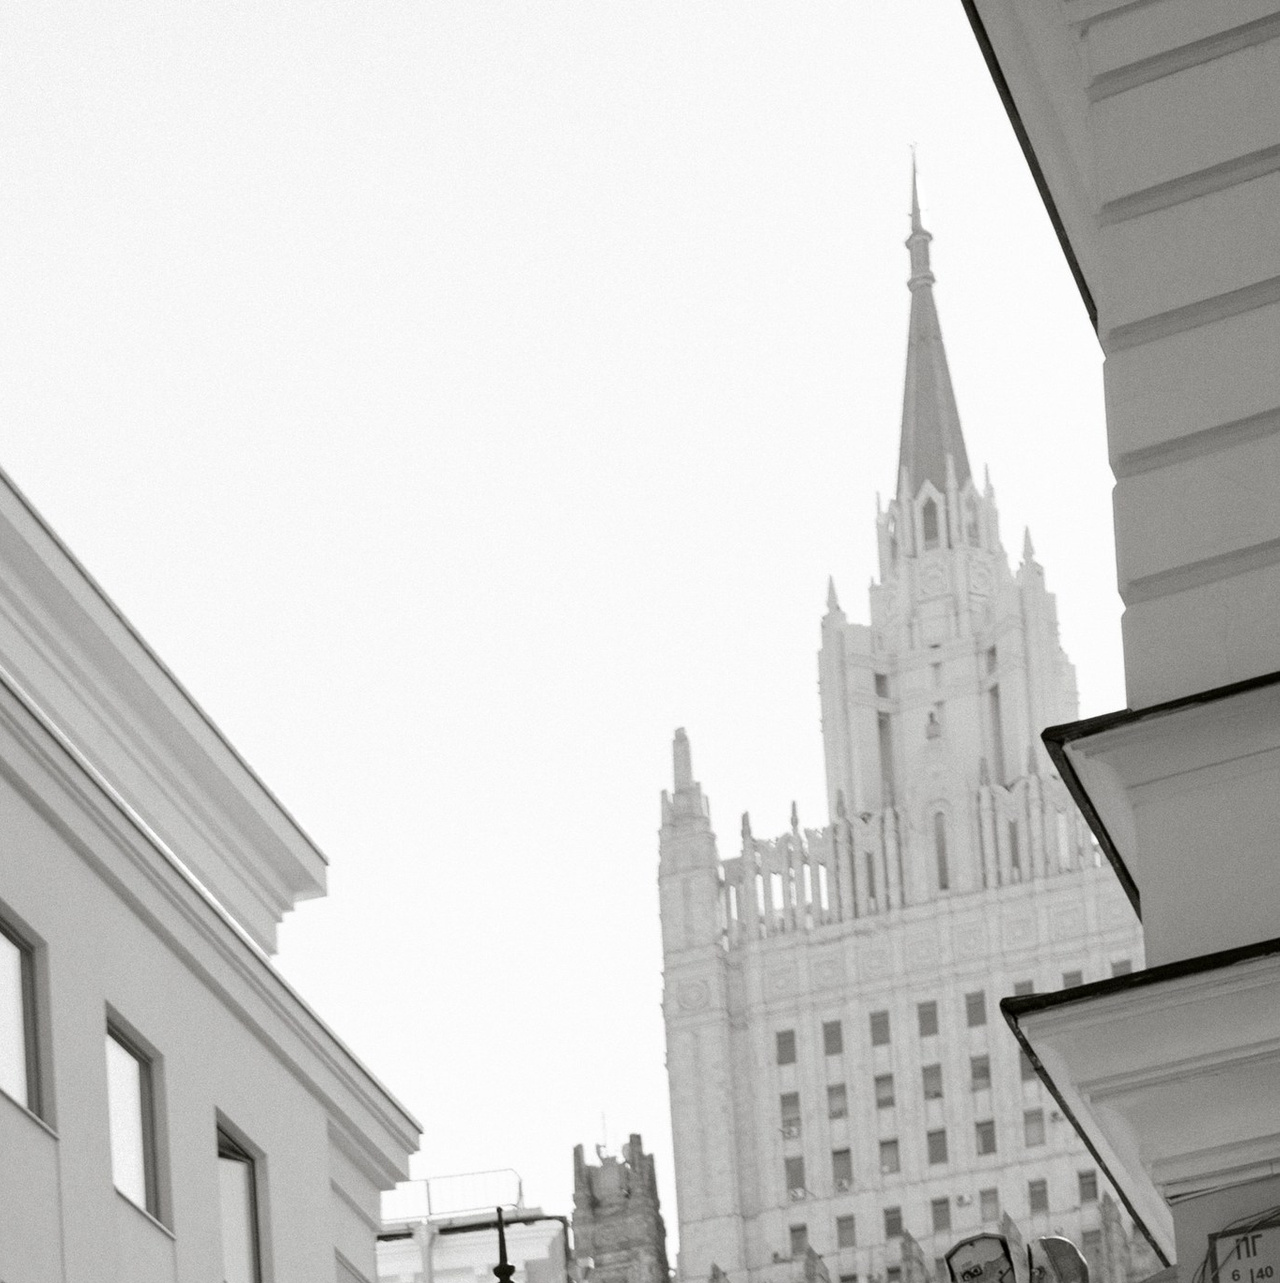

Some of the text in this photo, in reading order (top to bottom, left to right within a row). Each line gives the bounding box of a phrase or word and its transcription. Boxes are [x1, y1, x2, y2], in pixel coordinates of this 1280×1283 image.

[1235, 1233, 1263, 1260] ПГ
[1231, 1265, 1274, 1282] 6 40
